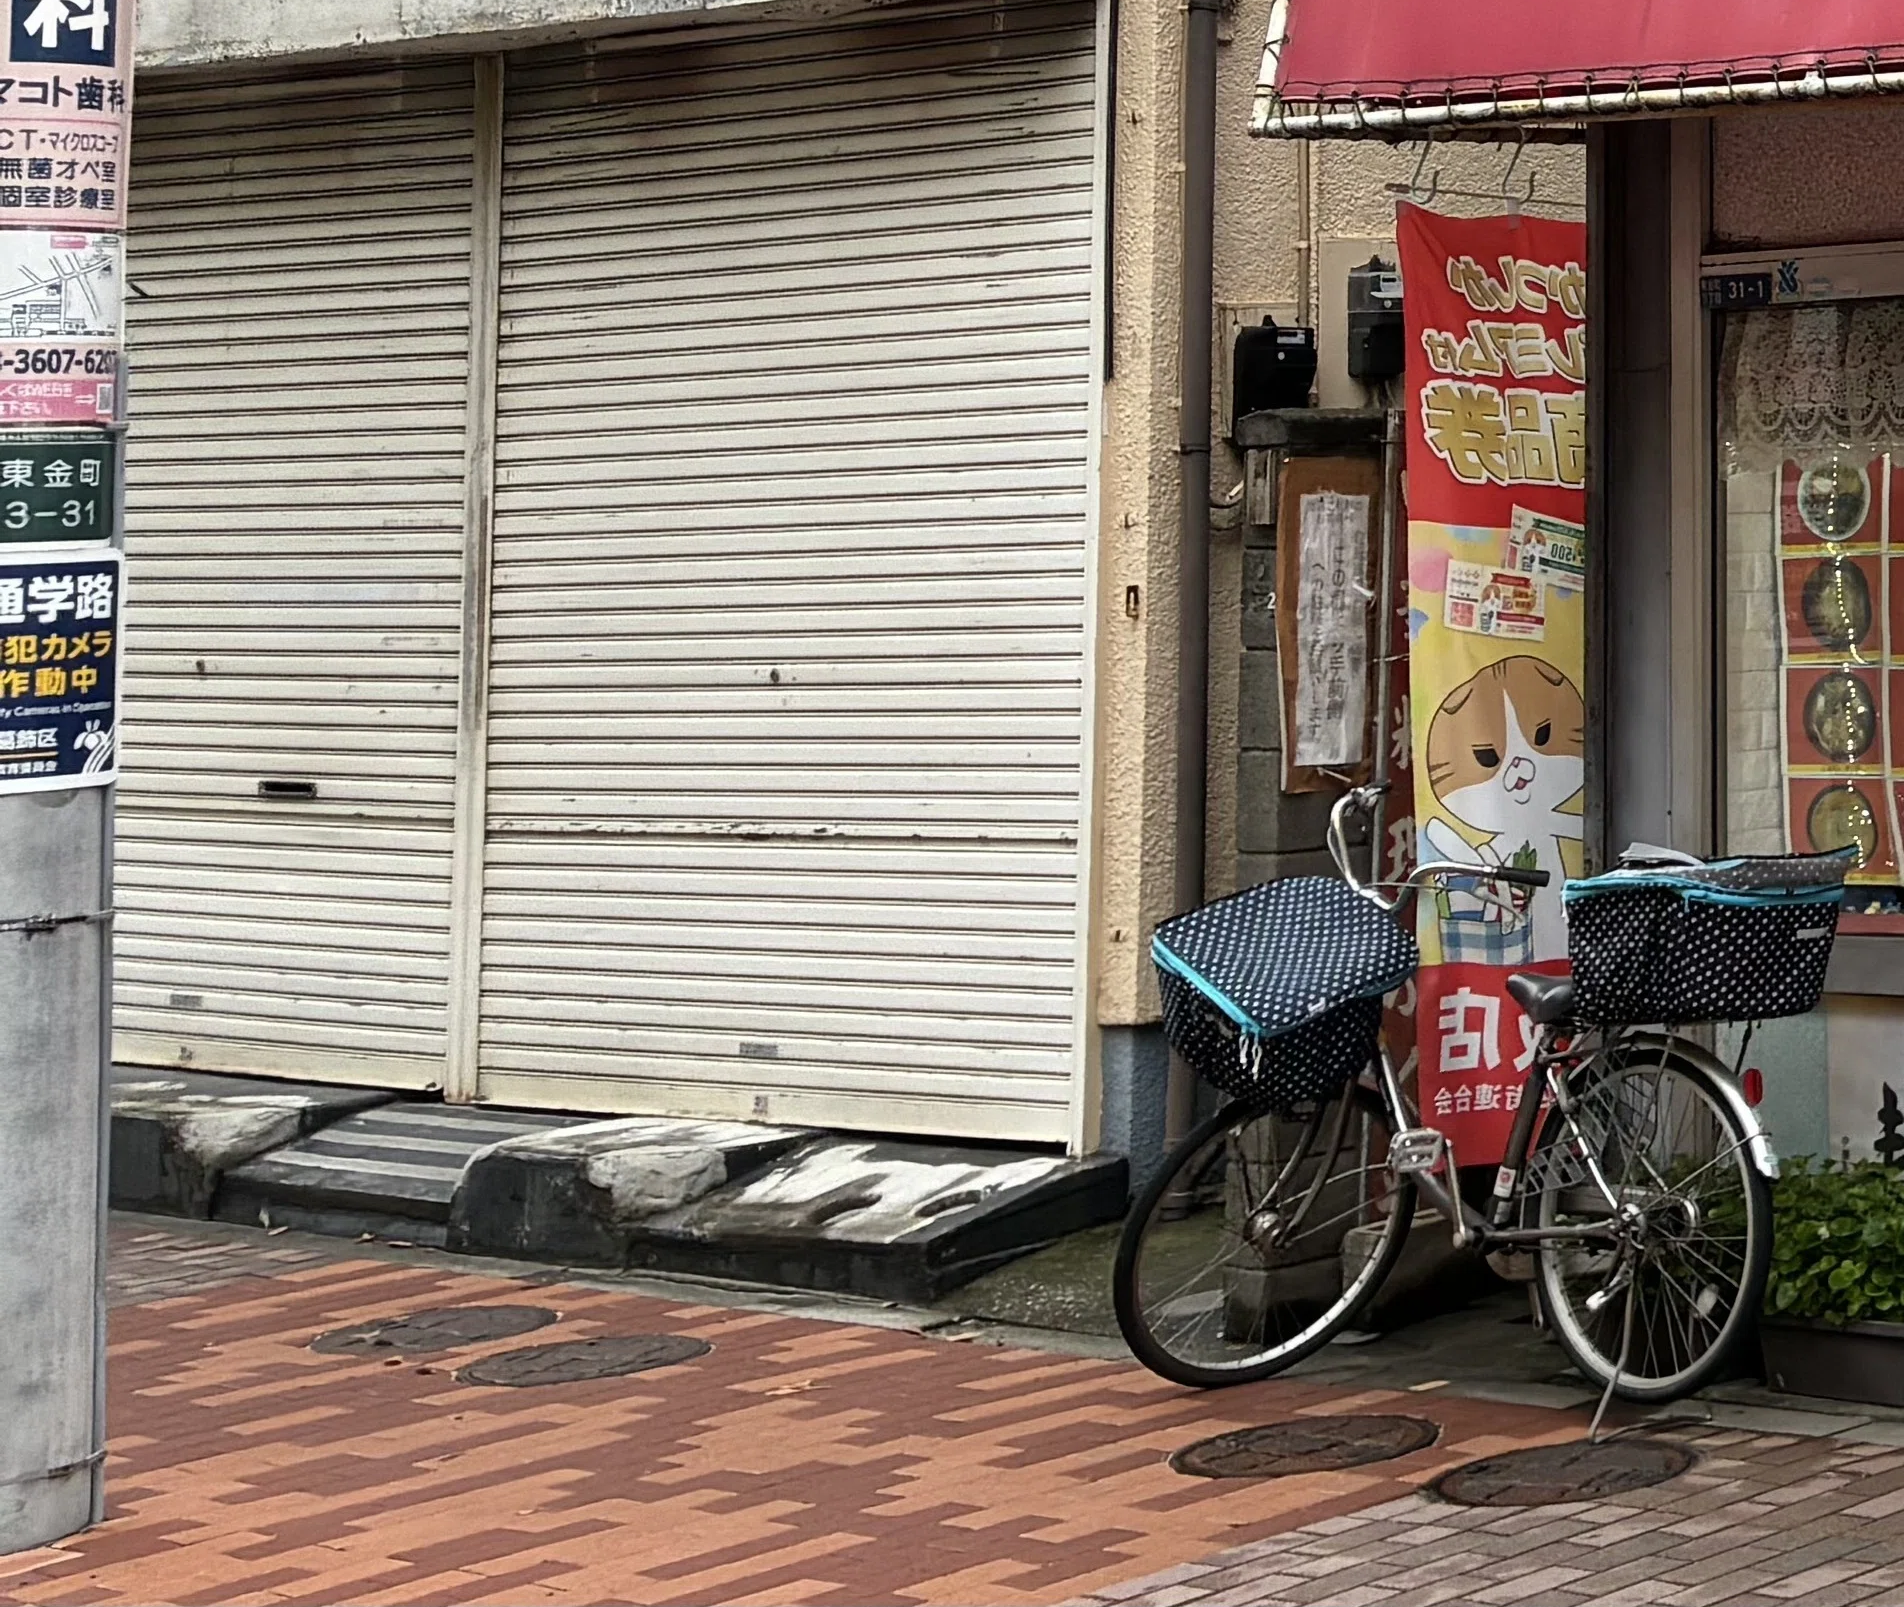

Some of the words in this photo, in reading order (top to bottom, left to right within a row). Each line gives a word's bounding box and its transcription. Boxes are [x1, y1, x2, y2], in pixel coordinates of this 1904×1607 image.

[0, 458, 101, 488] 東金町
[4, 499, 95, 529] 3-31
[0, 630, 113, 665] 犯カメラ
